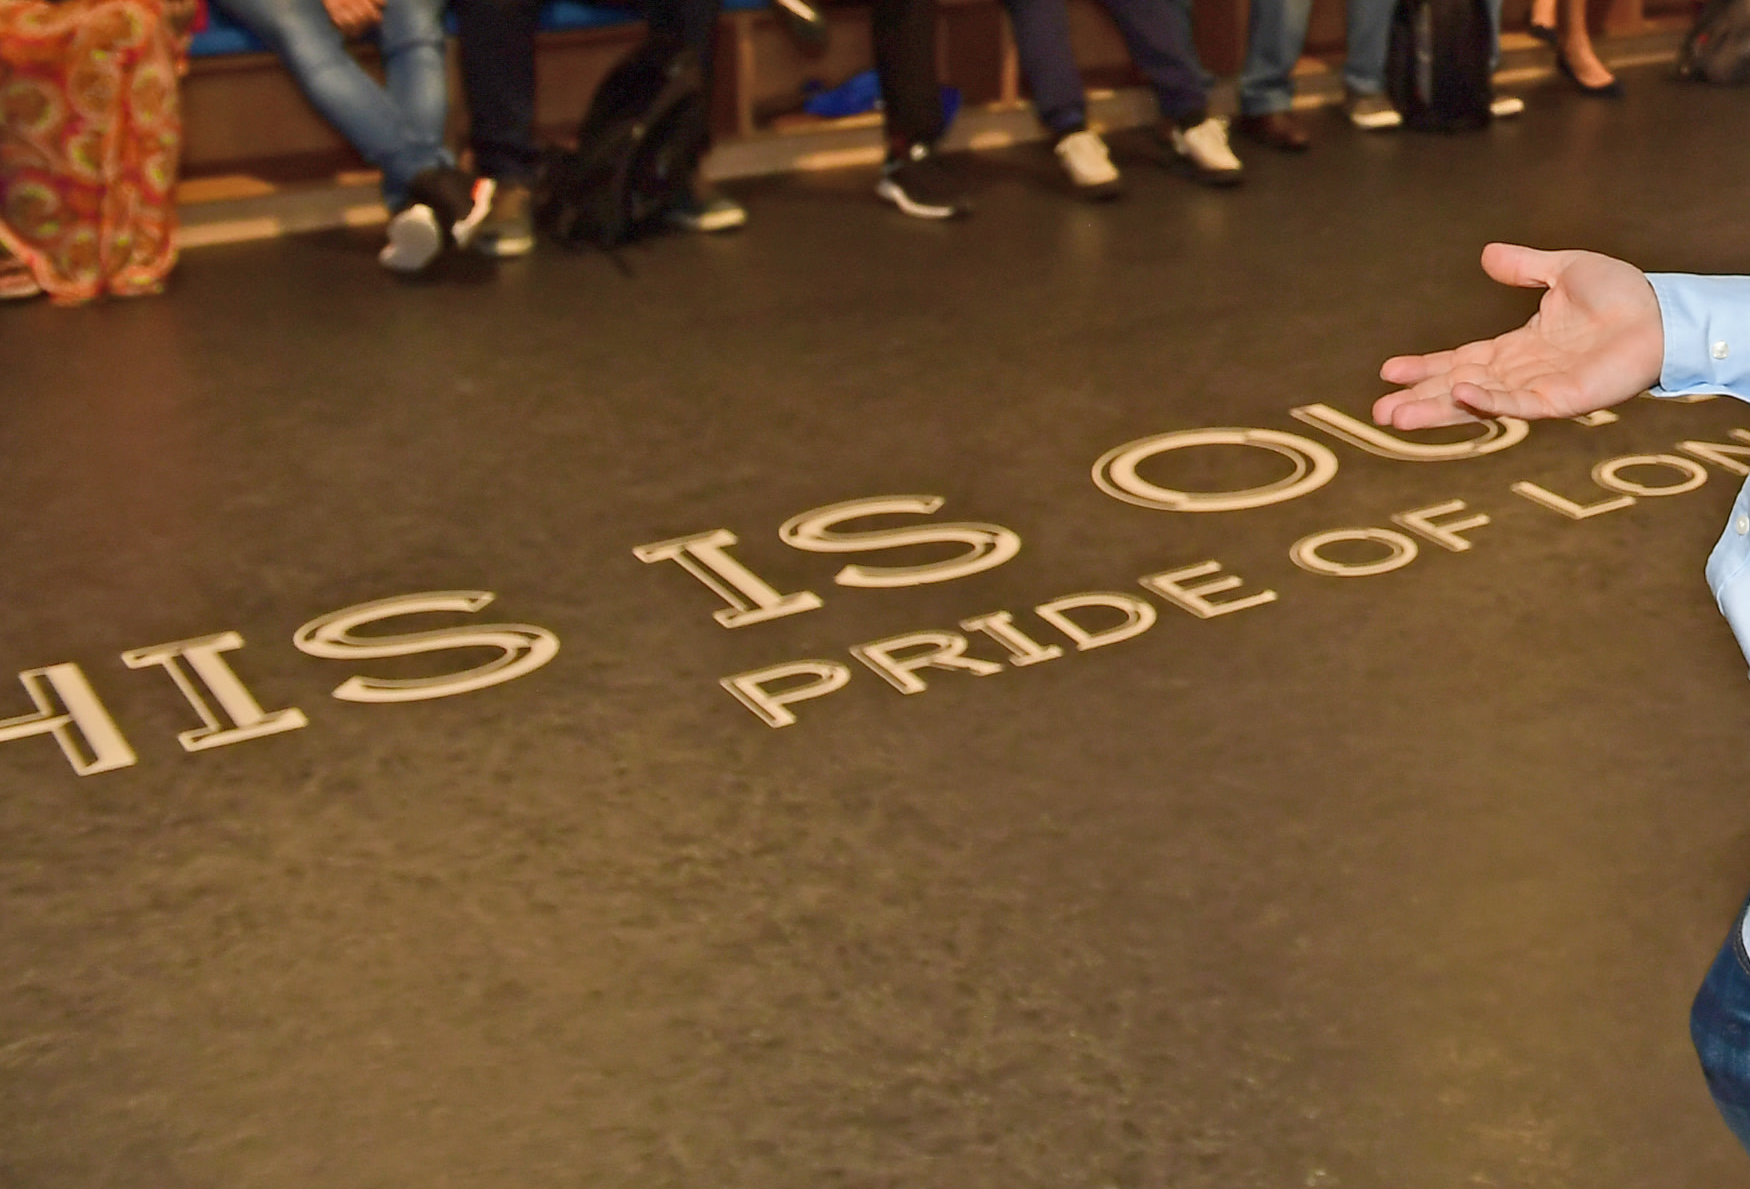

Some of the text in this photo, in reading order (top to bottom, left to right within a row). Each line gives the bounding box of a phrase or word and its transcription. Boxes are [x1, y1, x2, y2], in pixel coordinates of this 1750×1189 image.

[632, 494, 1021, 629] IS
[1091, 391, 1717, 513] OU
[718, 559, 1278, 729] PRIDE
[1288, 499, 1490, 577] OF
